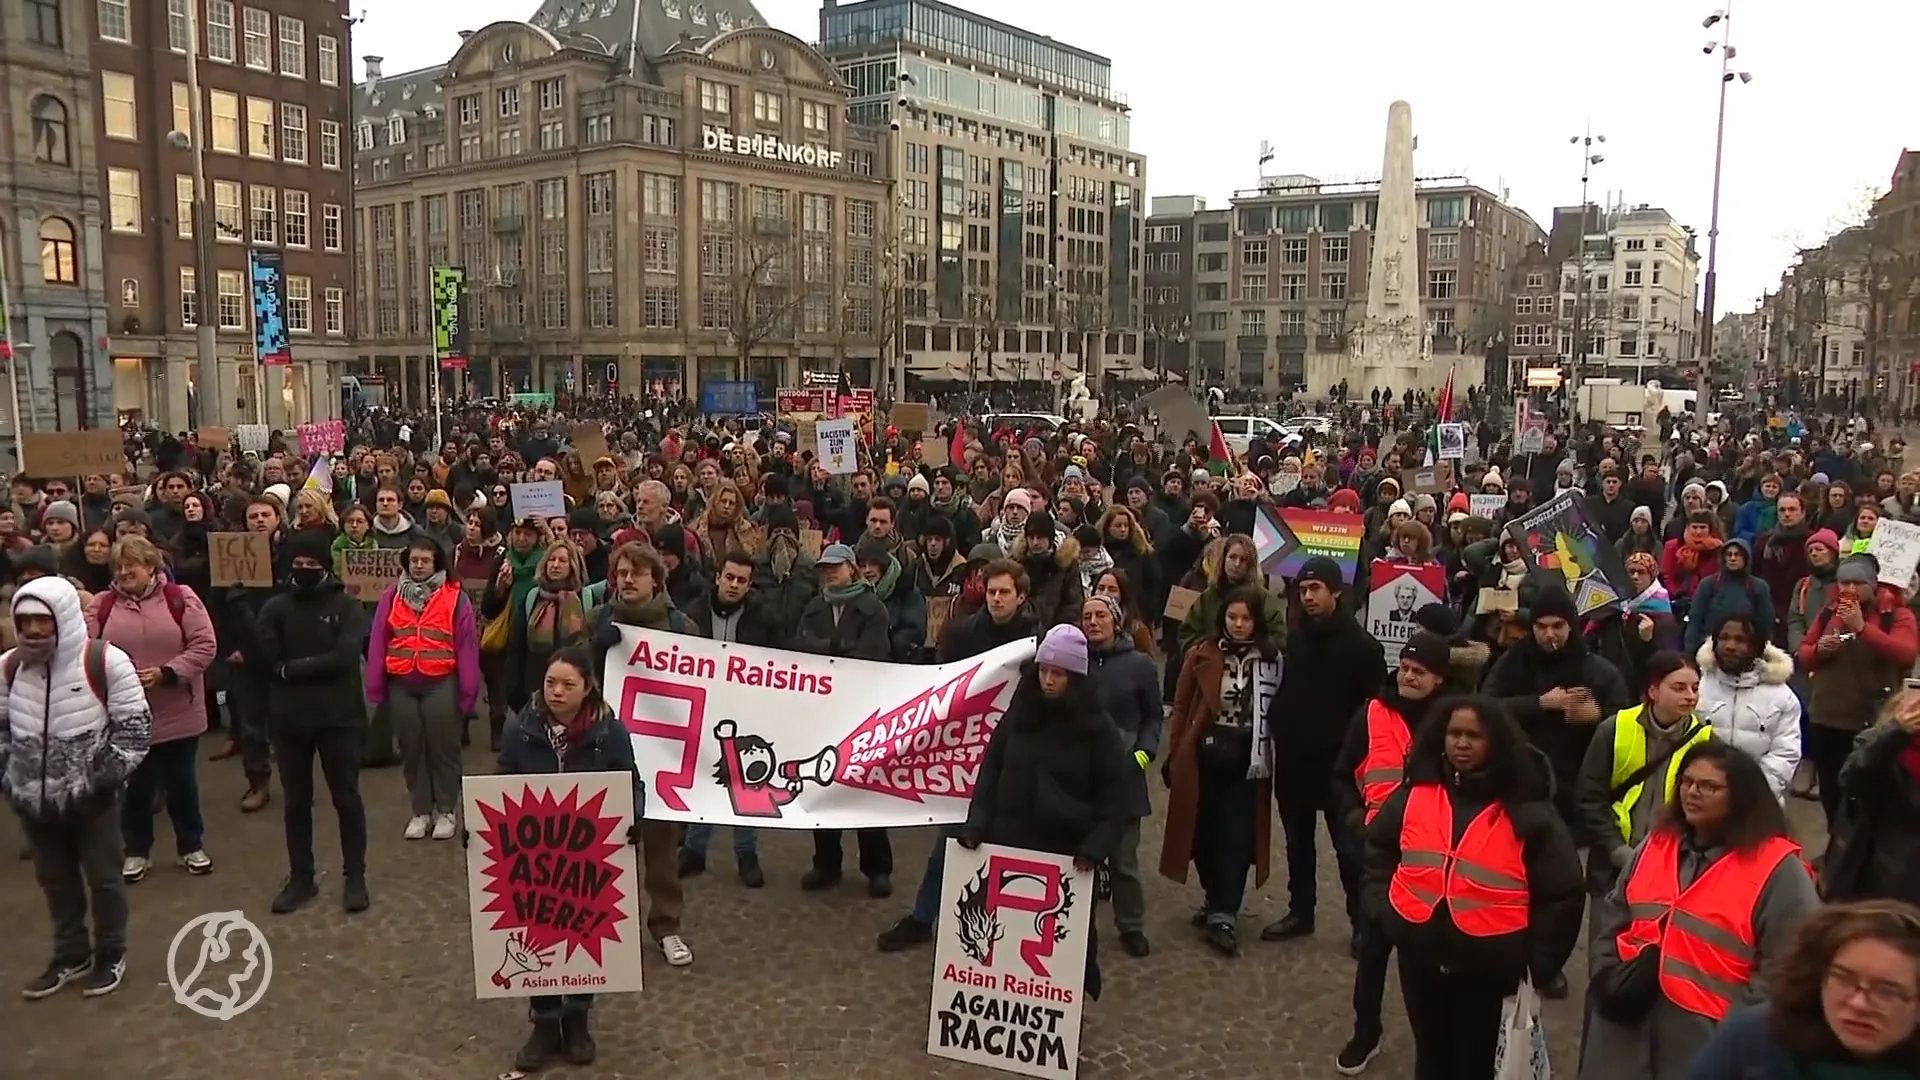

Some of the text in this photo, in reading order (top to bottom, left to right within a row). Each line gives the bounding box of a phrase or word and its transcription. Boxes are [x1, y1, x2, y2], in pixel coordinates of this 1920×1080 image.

[703, 129, 842, 168] DE BIJENKORF
[820, 429, 851, 439] RACISTEN
[829, 439, 844, 447] ZIJN
[830, 447, 844, 455] KUT
[217, 536, 257, 557] FCK
[345, 550, 401, 566] RESPEC
[1307, 548, 1329, 557] VOOR
[219, 558, 257, 580] PVV
[627, 640, 833, 695] Asian Raisins
[850, 711, 1004, 763] OUR VOICES
[888, 745, 985, 766] AGAINST
[498, 814, 597, 858] LOUD
[508, 851, 612, 900] ASIAN
[511, 889, 609, 939] HERE!
[521, 973, 607, 988] Asian Raisins
[942, 963, 1074, 1004] Asian Raisins
[949, 990, 1065, 1034] AGAINST
[937, 1010, 1070, 1071] RACISM
